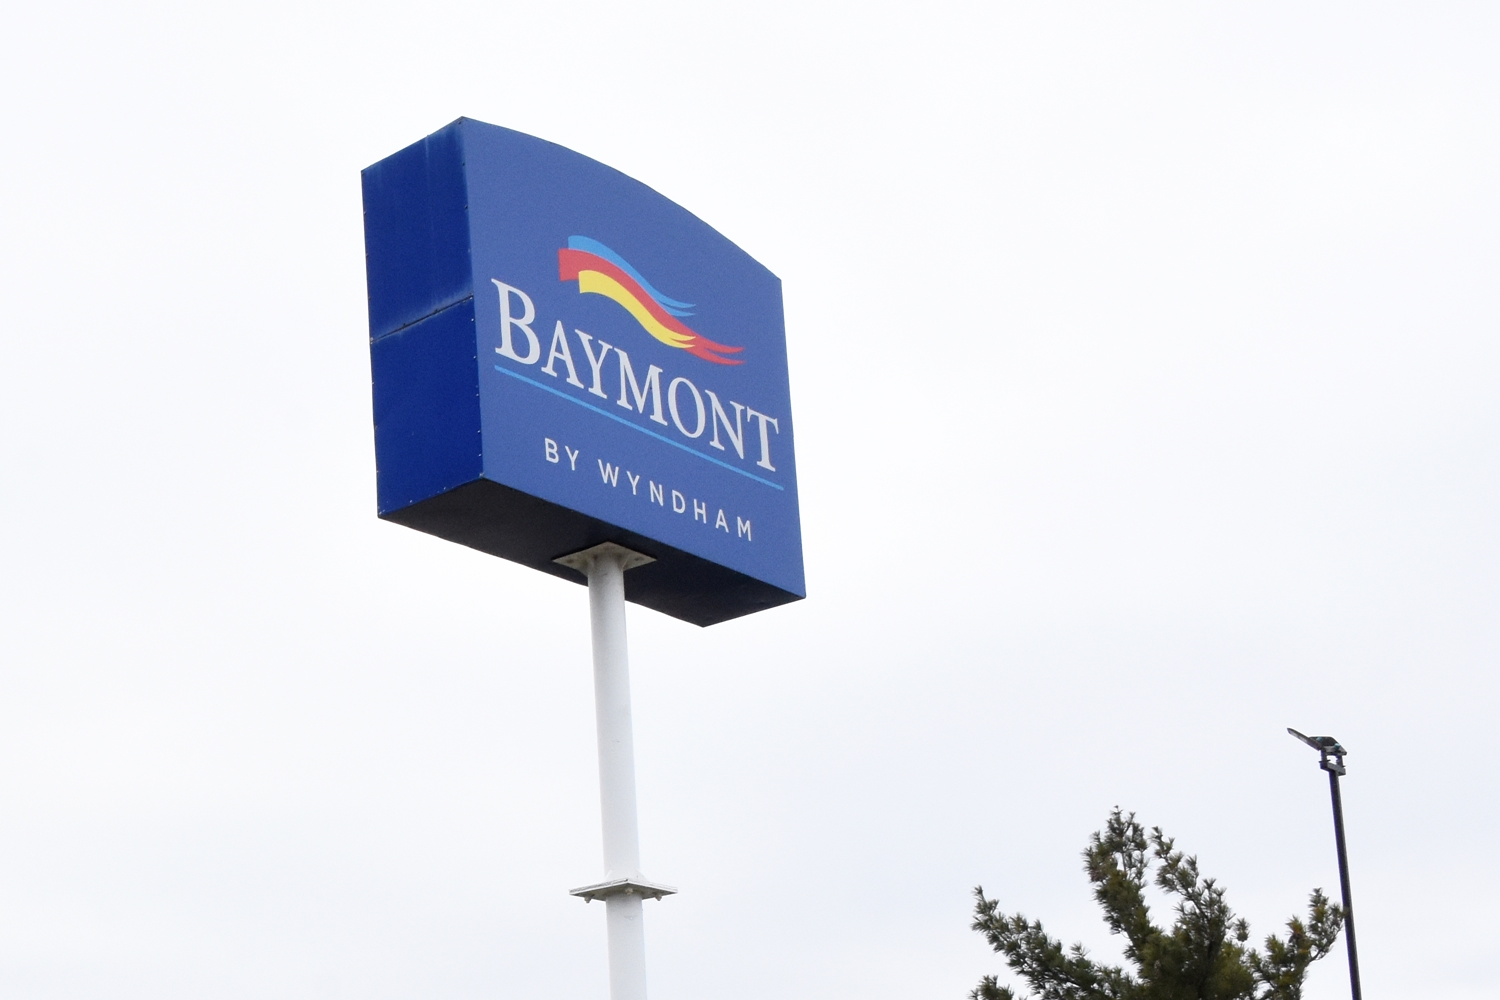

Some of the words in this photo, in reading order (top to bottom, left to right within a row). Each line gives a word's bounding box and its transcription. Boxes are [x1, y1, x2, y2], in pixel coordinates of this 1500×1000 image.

[491, 278, 779, 472] BAYMONT
[544, 437, 579, 471] BY
[598, 459, 752, 542] WYNDHAM
